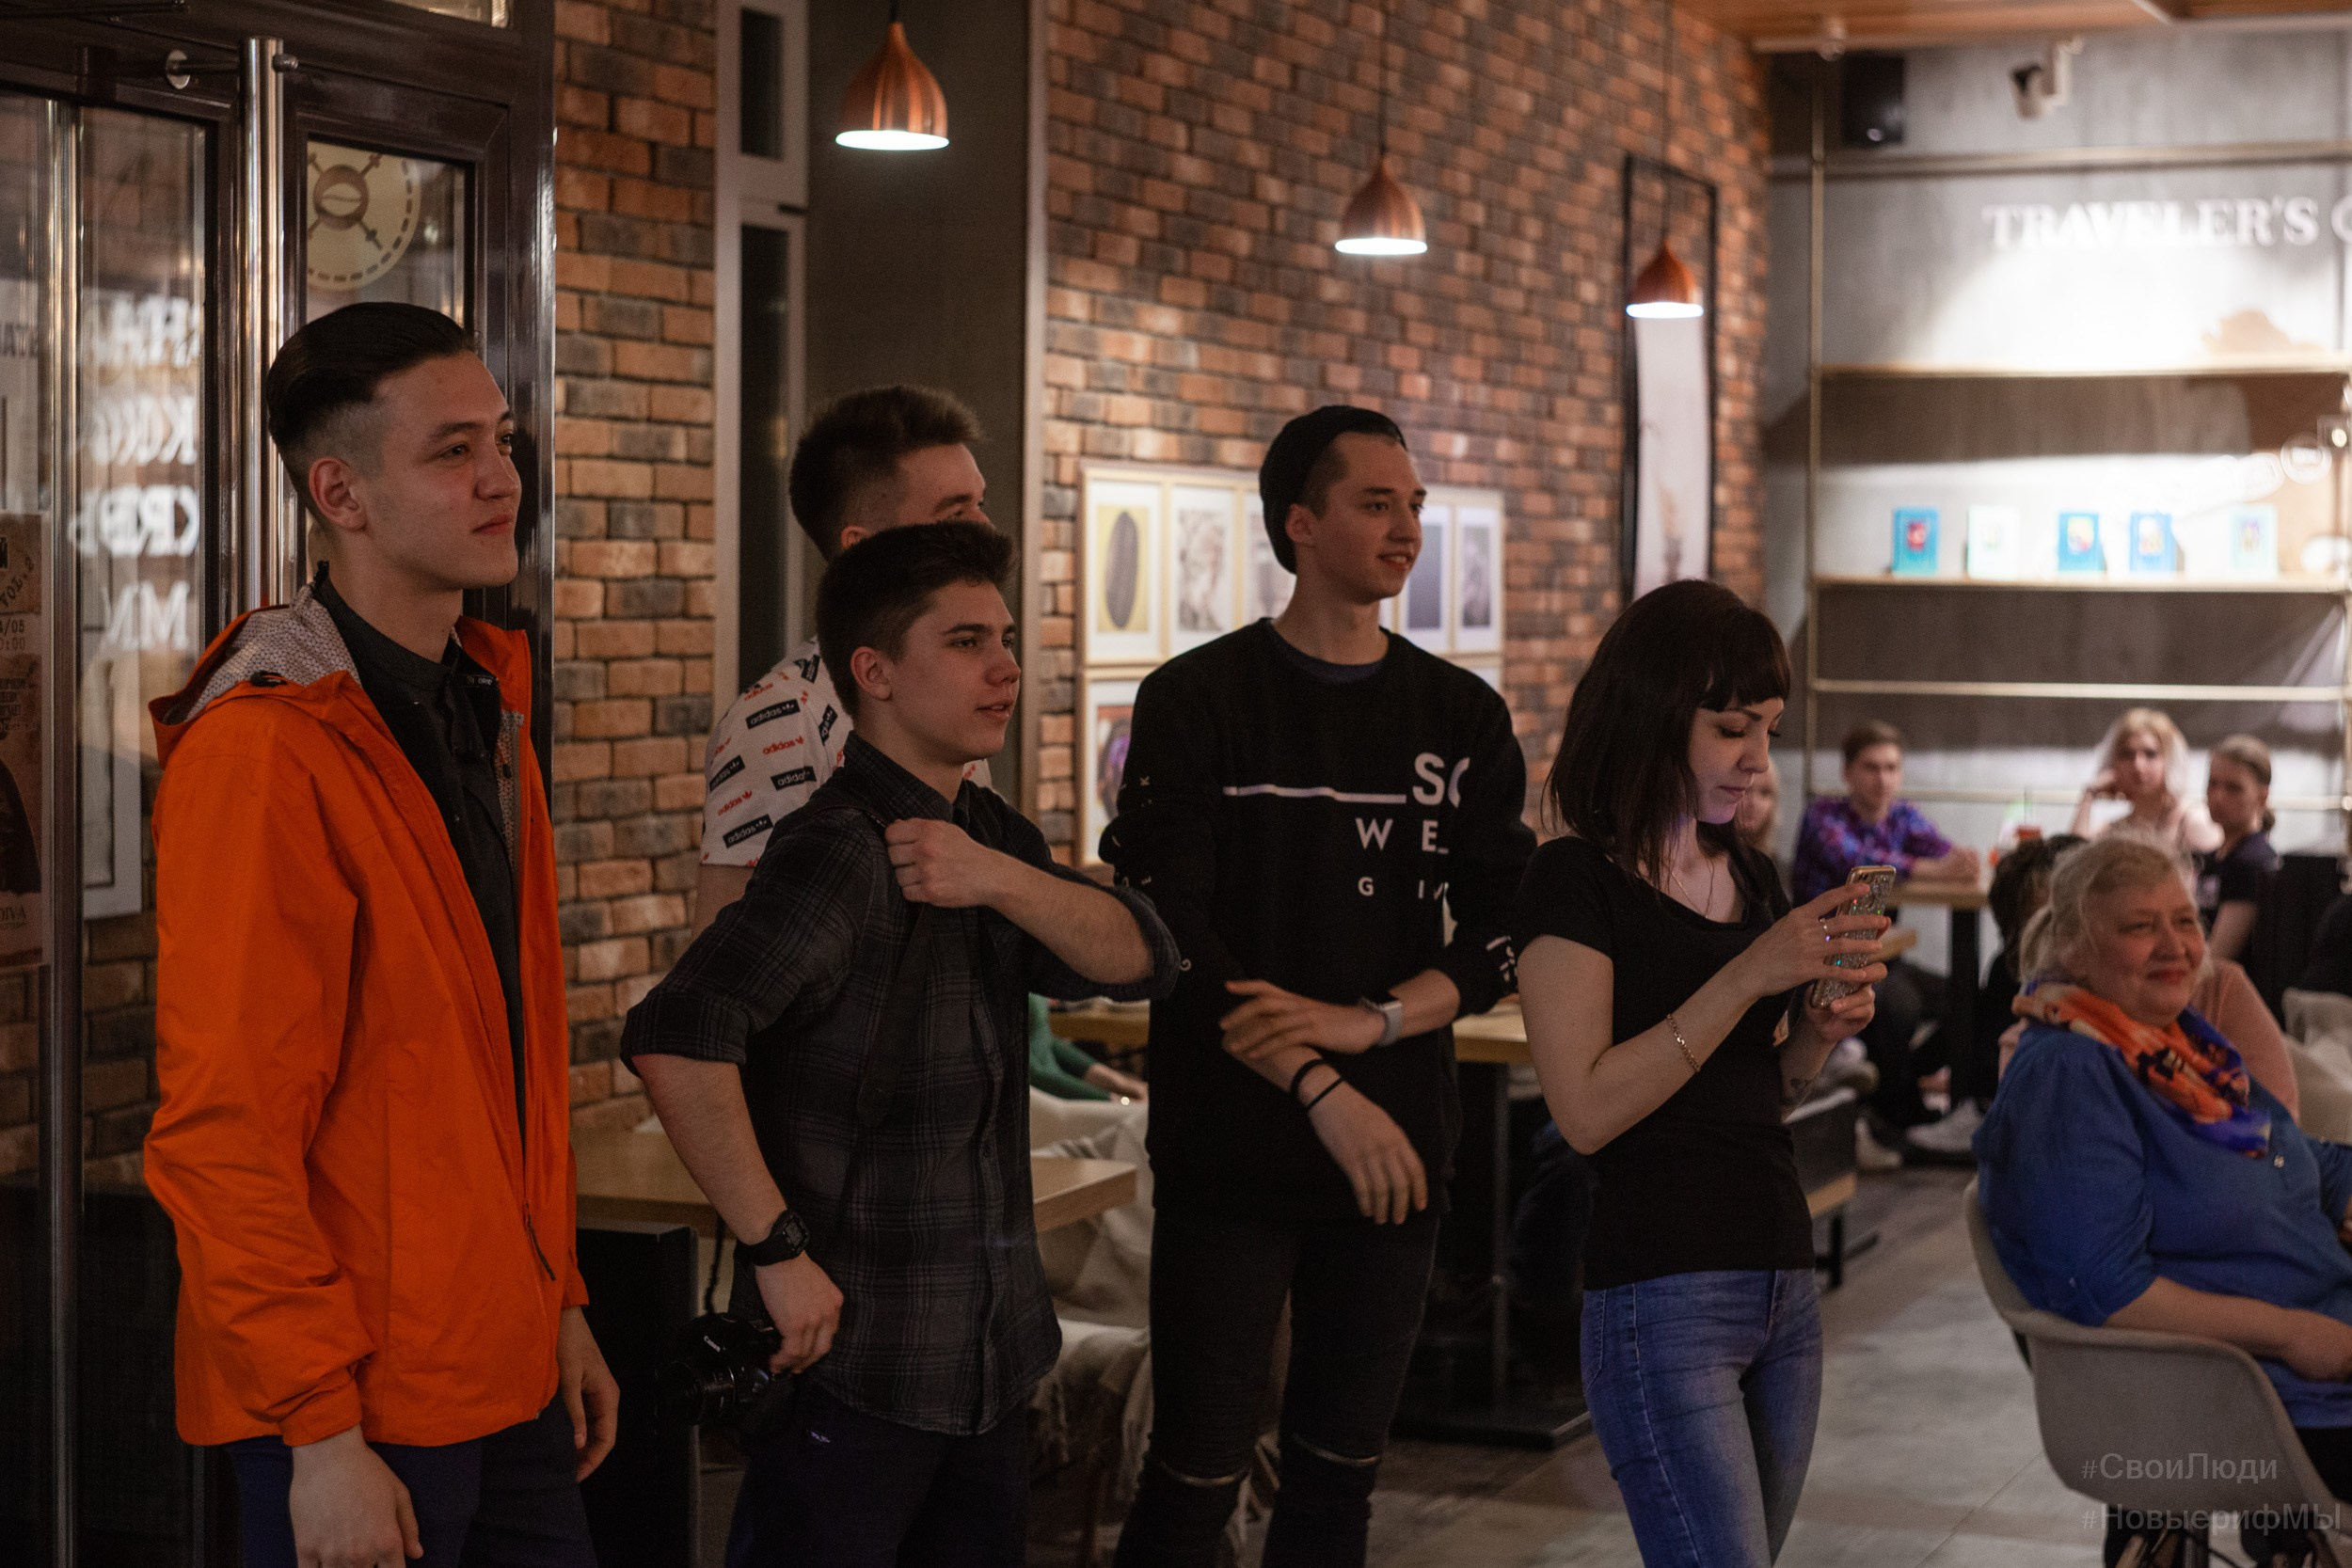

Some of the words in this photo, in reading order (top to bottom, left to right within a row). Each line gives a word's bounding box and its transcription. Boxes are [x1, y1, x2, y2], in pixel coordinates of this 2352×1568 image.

[1982, 197, 2320, 250] TRAVELER'S
[750, 706, 783, 725] adidas
[762, 739, 796, 755] adidas
[727, 826, 757, 845] adidas
